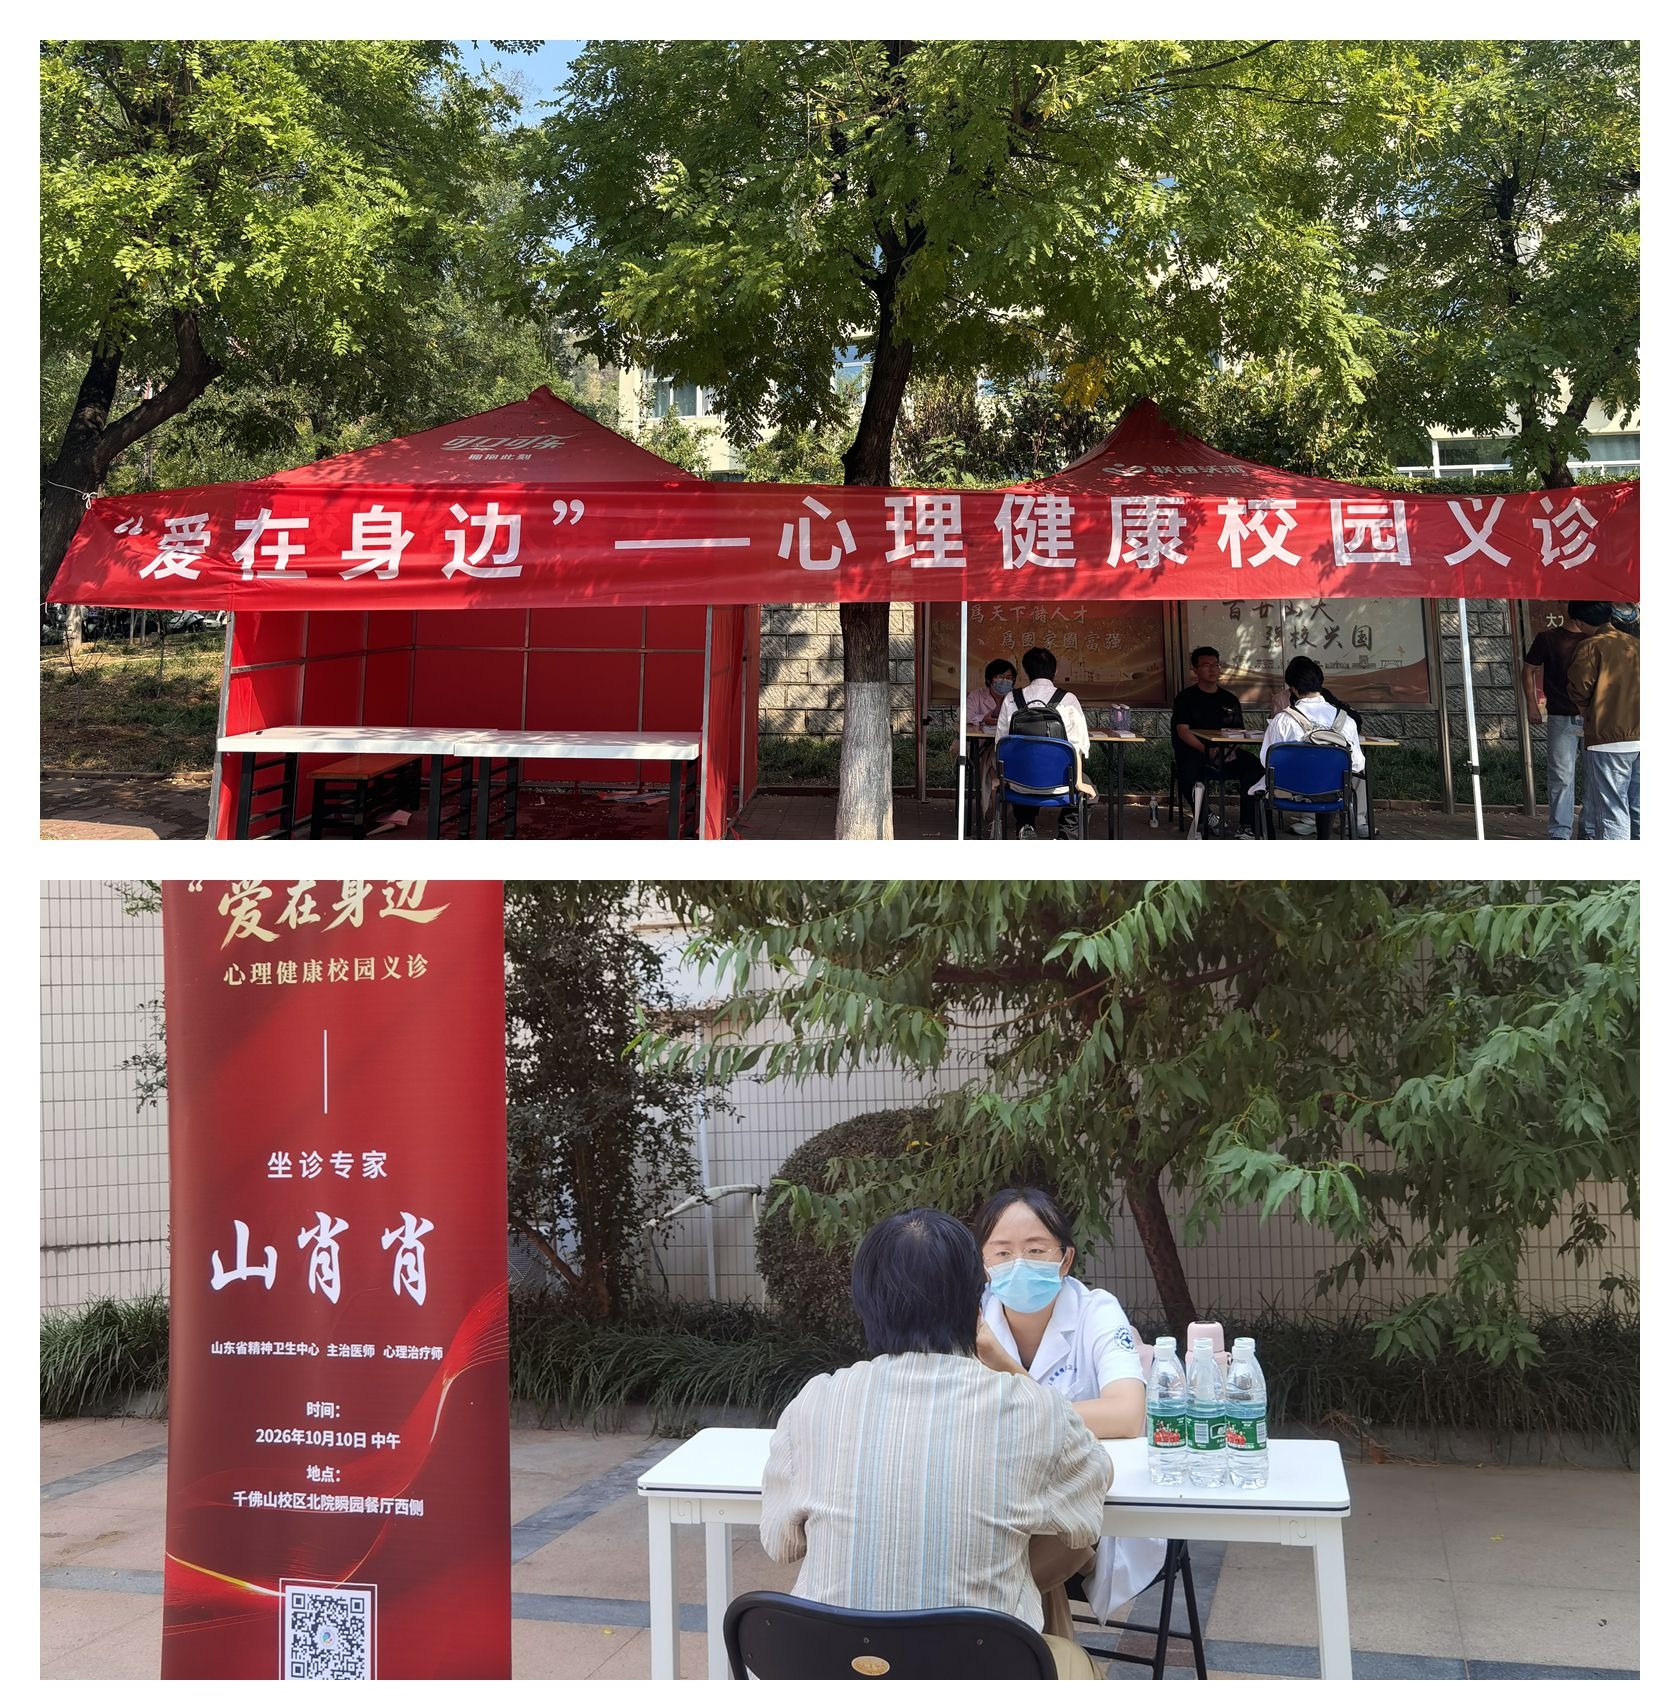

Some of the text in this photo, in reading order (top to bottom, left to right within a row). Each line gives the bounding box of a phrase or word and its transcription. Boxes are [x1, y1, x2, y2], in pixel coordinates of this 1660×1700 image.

[440, 432, 584, 451] 可口可乐
[113, 494, 1598, 580] “爱在身边”——心理健康校园义诊
[223, 953, 429, 986] 心理健康校园义诊
[267, 1151, 388, 1179] 坐诊专家
[210, 1211, 435, 1306] 山肖肖
[211, 1341, 443, 1361] 山东省精神卫生中心 主治医师 心理治疗师
[306, 1401, 341, 1418] 时间：
[255, 1428, 401, 1449] 2026年10月10日 中午
[306, 1465, 341, 1482] 地点：
